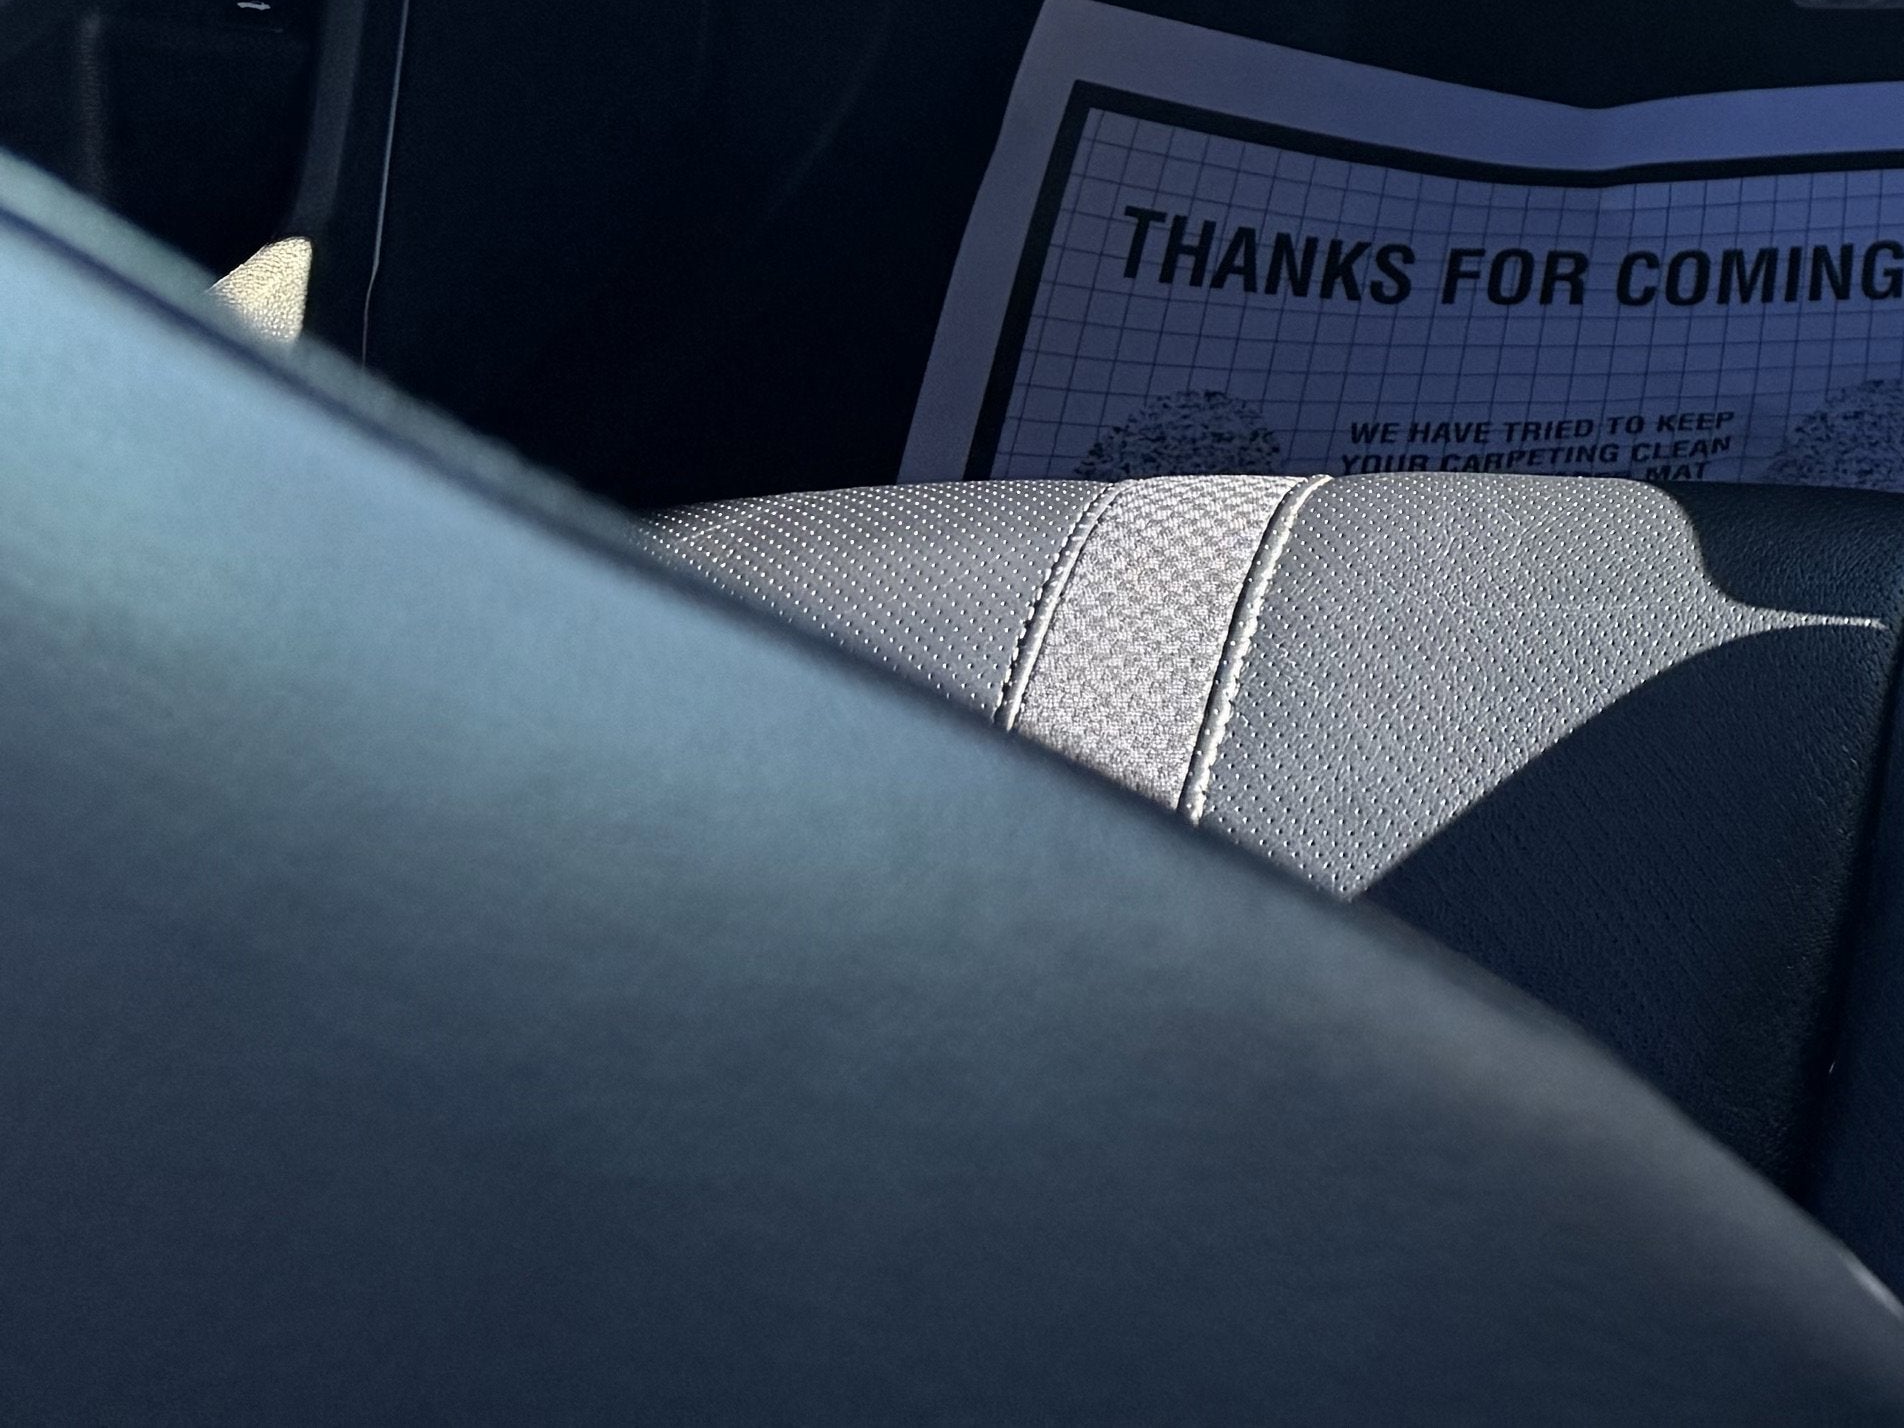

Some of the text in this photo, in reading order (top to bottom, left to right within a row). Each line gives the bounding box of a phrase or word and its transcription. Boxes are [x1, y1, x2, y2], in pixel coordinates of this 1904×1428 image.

[1123, 205, 1415, 305] THANKS
[1441, 247, 1589, 306] FOR
[1350, 412, 1735, 444] WE HAVE TRIED TO KEEP
[1341, 436, 1731, 476] YOUR CARPETING CLEAN
[1645, 461, 1710, 481] MAT
